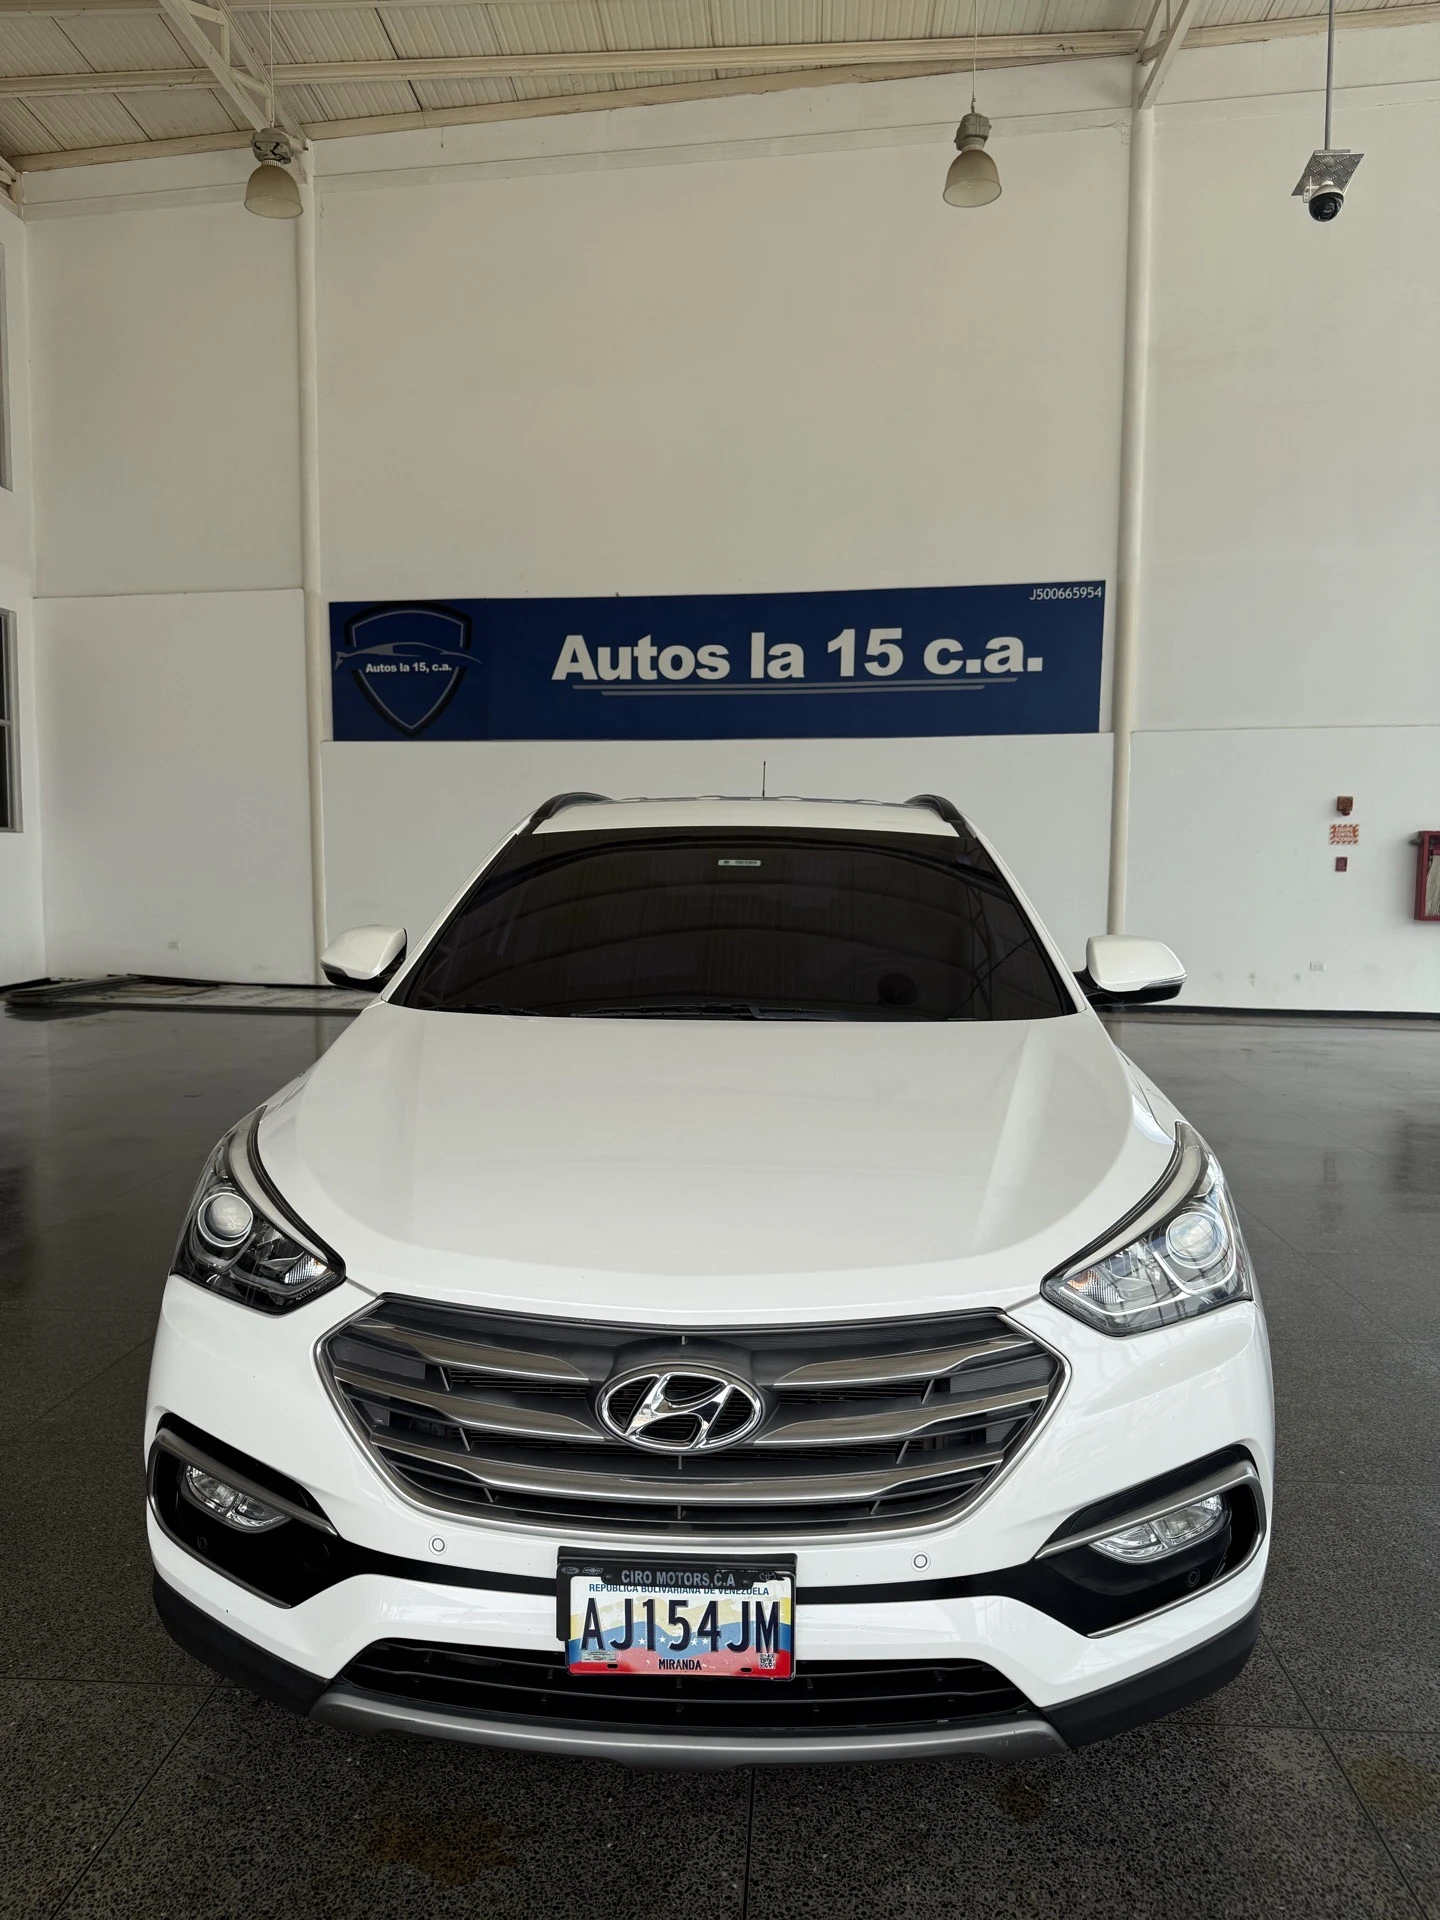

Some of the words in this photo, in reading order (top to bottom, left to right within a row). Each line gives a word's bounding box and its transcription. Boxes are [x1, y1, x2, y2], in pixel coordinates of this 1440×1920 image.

[1029, 586, 1102, 601] J500665954
[552, 634, 730, 681] Autos
[751, 632, 805, 679] la
[827, 628, 904, 677] 15
[923, 636, 1043, 675] c.a.
[365, 662, 398, 673] Autos
[399, 662, 410, 672] la
[412, 662, 430, 674] 15,
[431, 663, 452, 672] c.a.
[621, 1569, 652, 1584] CIRO
[581, 1597, 781, 1654] AJ154JM
[658, 1658, 702, 1670] MIRANDA
